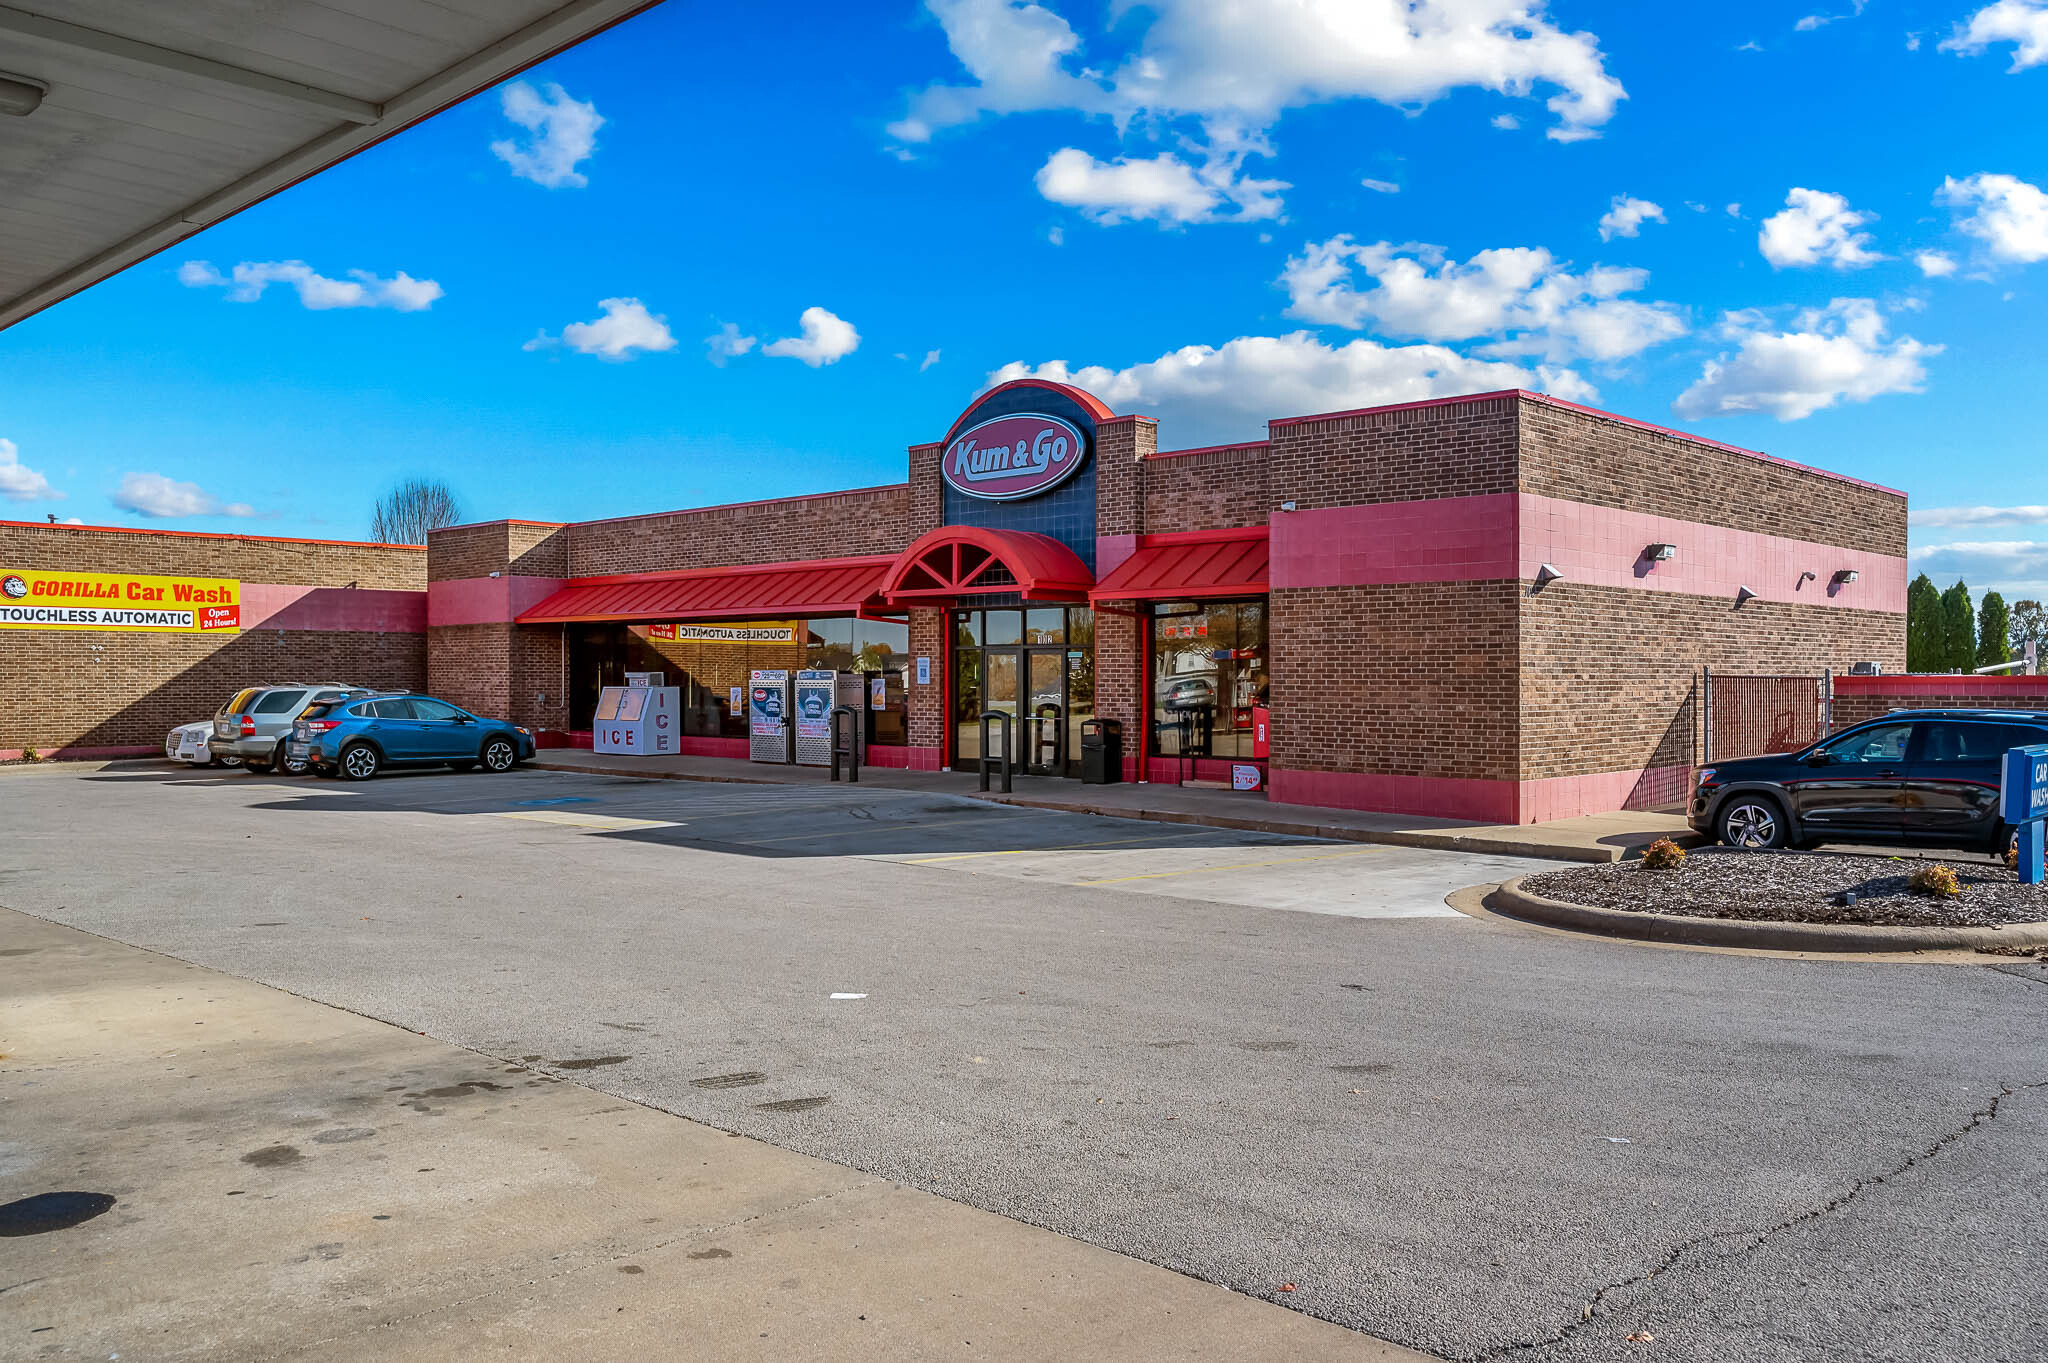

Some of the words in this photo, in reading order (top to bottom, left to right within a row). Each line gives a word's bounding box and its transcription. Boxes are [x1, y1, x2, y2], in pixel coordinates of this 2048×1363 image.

[954, 439, 1010, 482] Kum
[1012, 440, 1029, 468] &
[1032, 428, 1069, 471] Go
[32, 580, 120, 599] GORILLA
[126, 582, 165, 601] Car
[172, 584, 232, 604] Wash
[0, 608, 97, 623] TOUCHLESS
[101, 610, 192, 625] AUTOMATIC
[208, 608, 230, 619] Open
[203, 619, 213, 628] 24
[214, 617, 237, 627] Hours!
[637, 679, 647, 688] ICE
[655, 692, 669, 751] ICE
[602, 729, 634, 746] ICE
[2035, 763, 2048, 783] CAR
